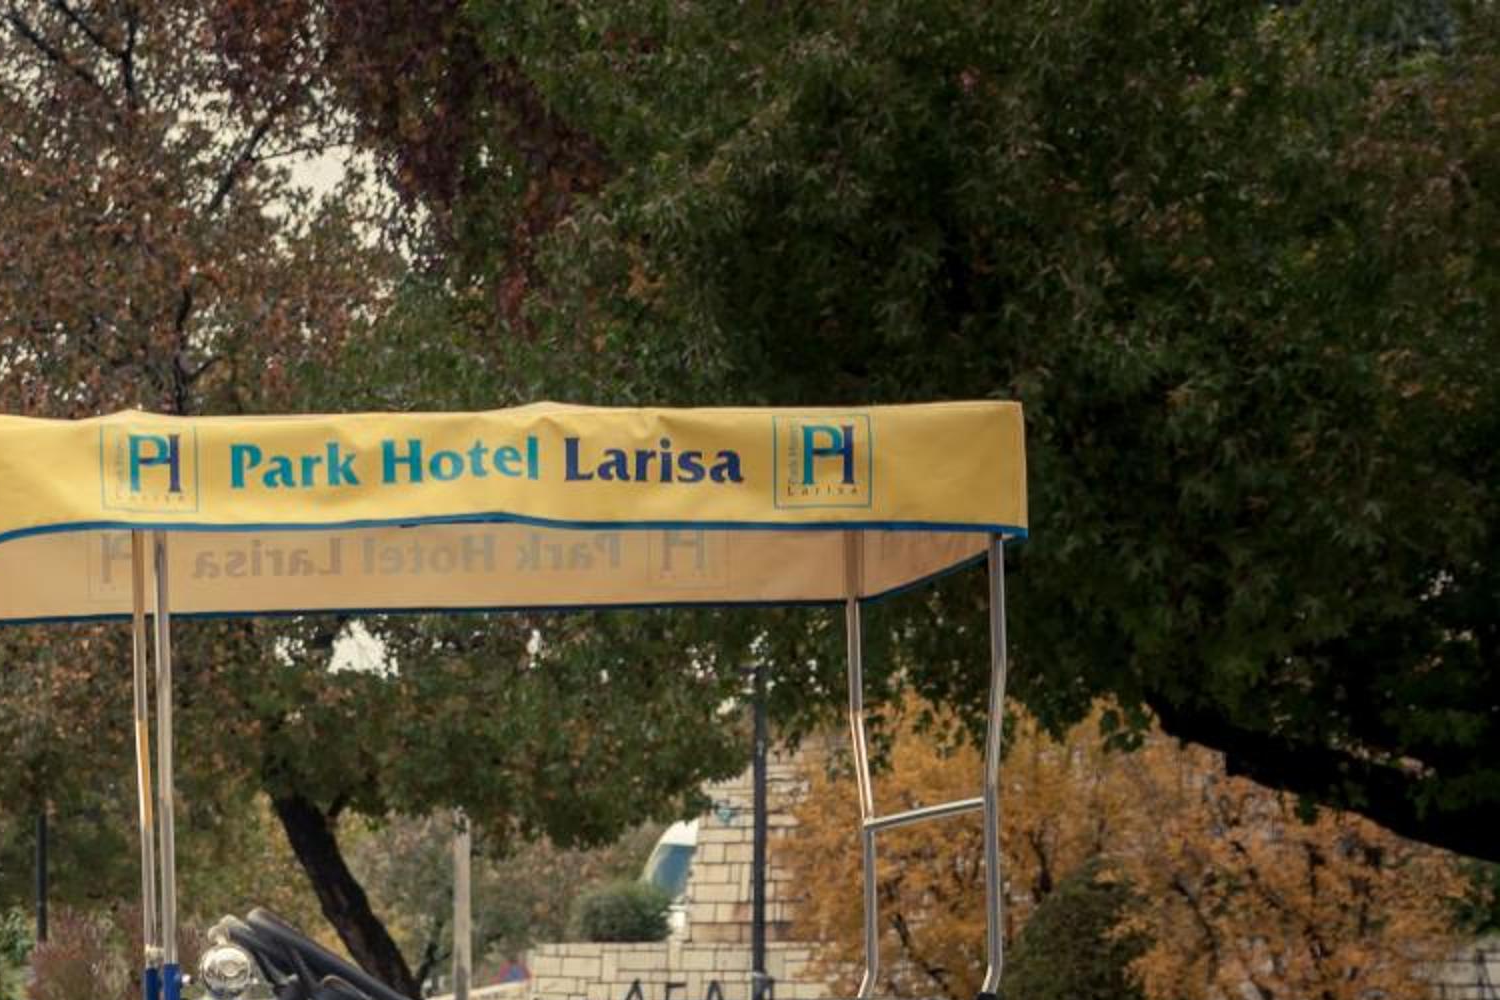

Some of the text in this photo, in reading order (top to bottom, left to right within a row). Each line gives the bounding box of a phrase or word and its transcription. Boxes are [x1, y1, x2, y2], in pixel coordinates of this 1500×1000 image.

[230, 442, 360, 488] Park
[382, 436, 538, 484] Hotel
[564, 437, 744, 483] Larisa
